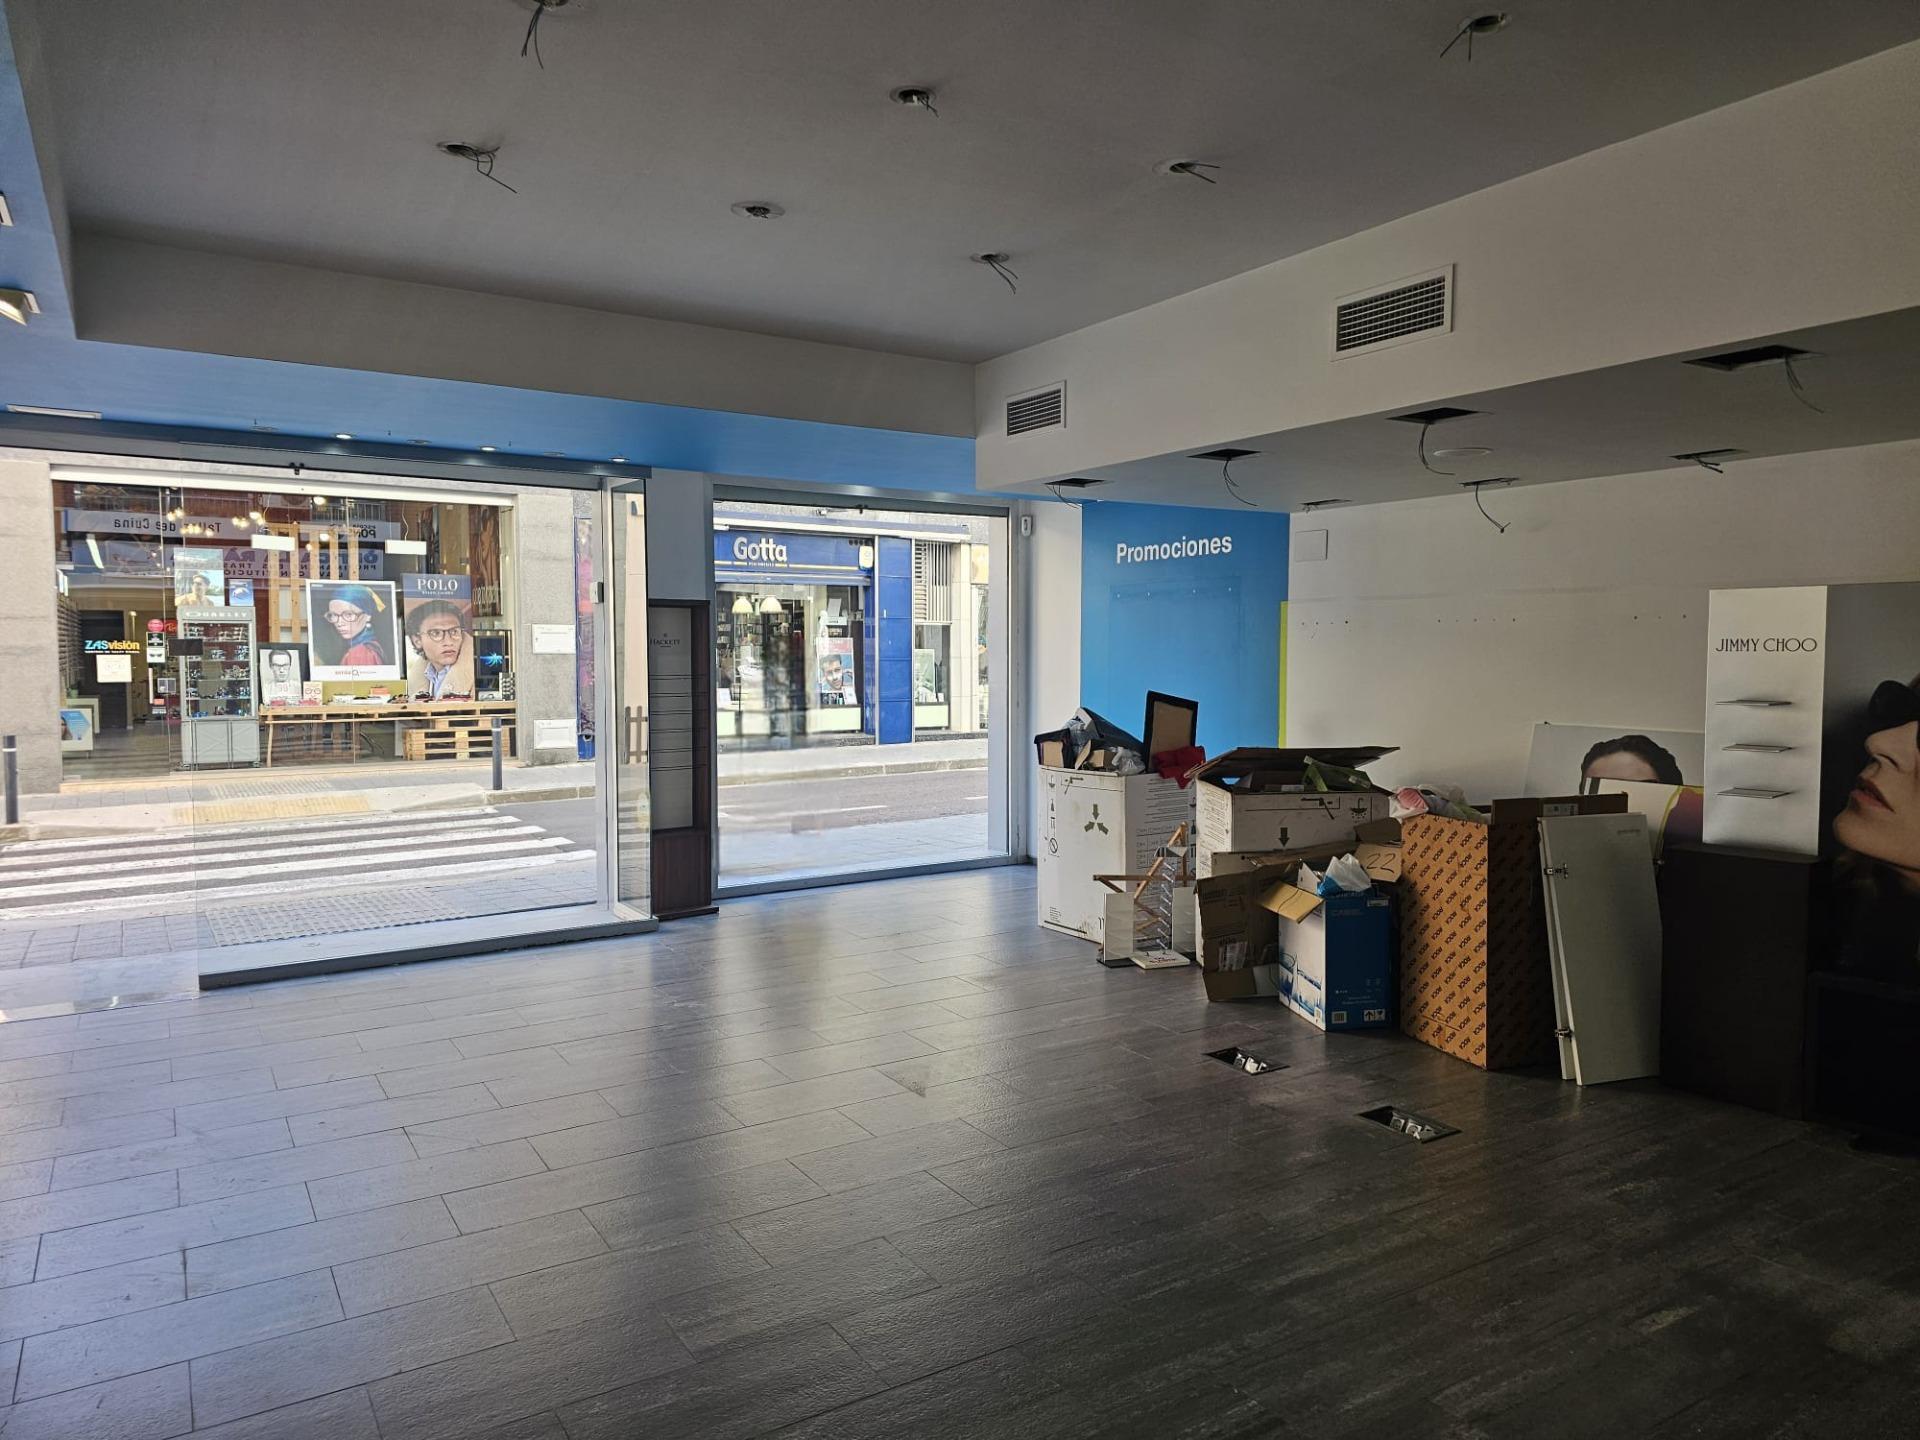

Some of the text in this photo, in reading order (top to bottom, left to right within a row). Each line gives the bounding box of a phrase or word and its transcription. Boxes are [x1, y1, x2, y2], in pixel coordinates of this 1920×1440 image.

[733, 536, 788, 562] Gotta
[1116, 536, 1232, 564] Promociones
[417, 578, 458, 591] POLO
[1715, 637, 1818, 653] JIMMY CHOO
[1366, 852, 1397, 873] 22
